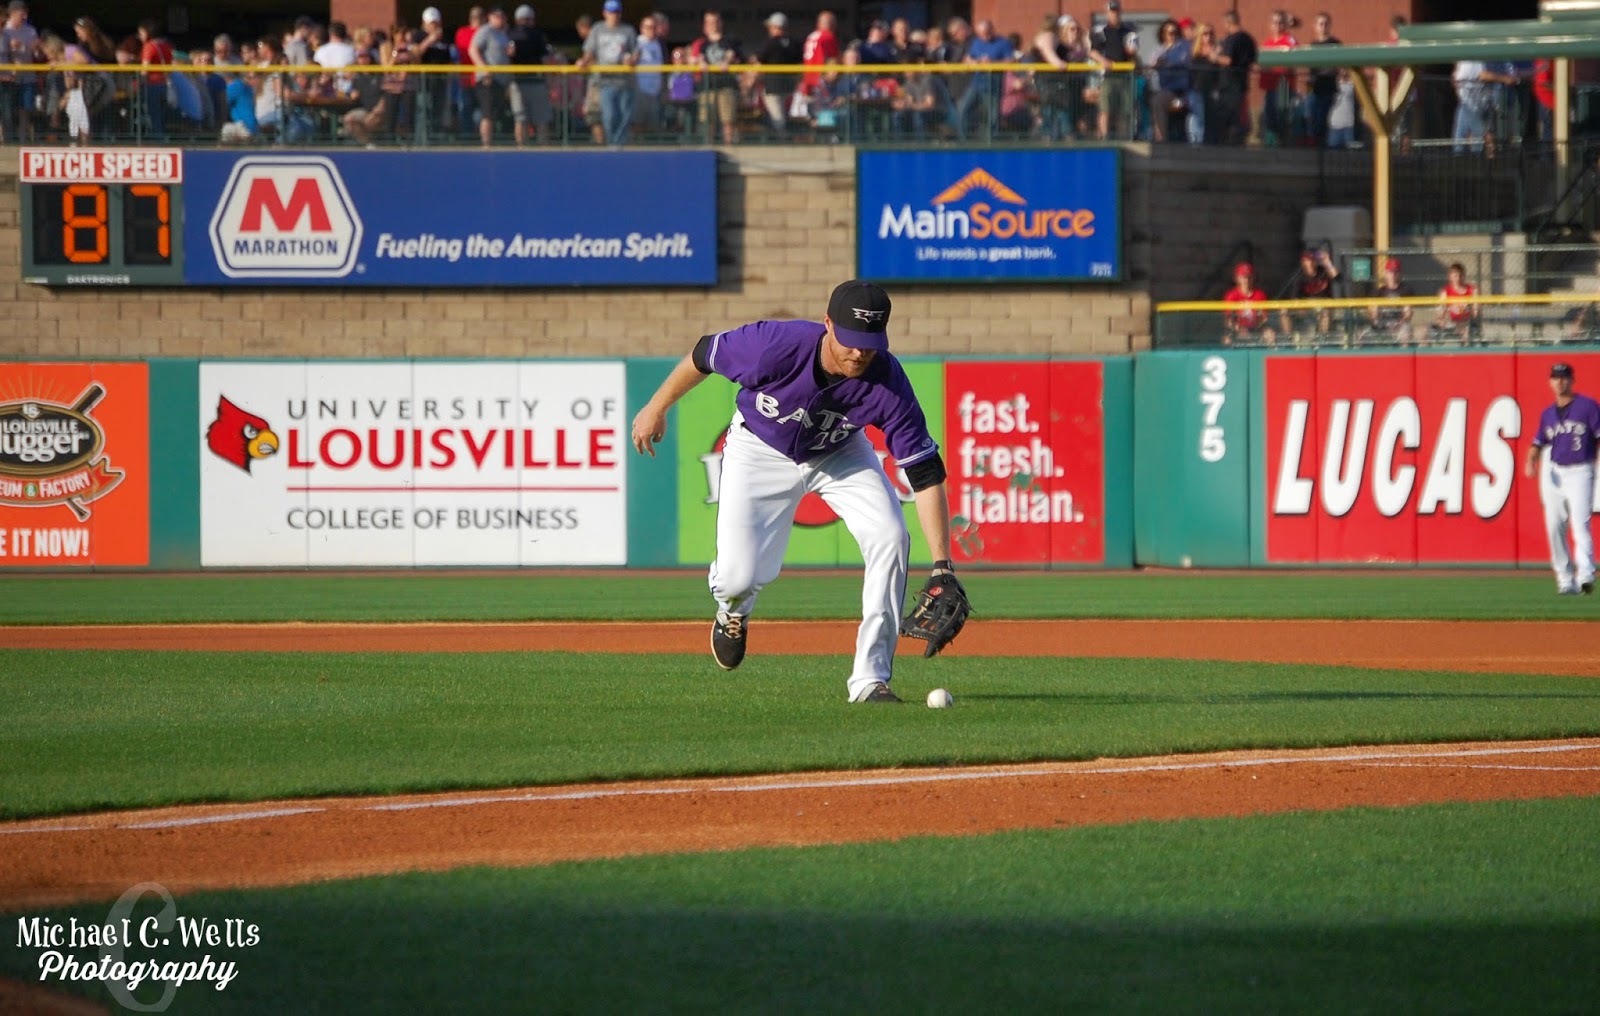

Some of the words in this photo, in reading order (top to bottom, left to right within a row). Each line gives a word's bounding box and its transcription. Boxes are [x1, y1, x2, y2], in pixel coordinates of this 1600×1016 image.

[29, 152, 95, 179] PITCH
[102, 152, 173, 179] SPEED
[238, 177, 333, 233] M
[62, 184, 170, 263] 87
[878, 202, 1095, 239] MainSource
[233, 239, 338, 257] MARATHON
[376, 233, 462, 262] Fueling
[466, 234, 504, 258] the
[505, 233, 621, 258] American
[624, 232, 693, 261] Spirit.
[917, 246, 940, 260] Life
[941, 246, 977, 260] needs
[988, 246, 1022, 262] great
[66, 275, 130, 284] DAKTRONICS
[287, 399, 539, 421] UNIVERSITY
[570, 399, 617, 421] OF
[959, 391, 1039, 433] fast.
[3, 420, 79, 434] LOUISVILLE
[808, 429, 849, 450] 26
[287, 428, 617, 471] LOUISVILLE
[959, 436, 1064, 478] fresh.
[1274, 395, 1521, 518] LUCAS
[1572, 435, 1582, 452] 3
[39, 472, 91, 498] FACTORY
[959, 482, 1085, 523] italian.
[287, 508, 404, 531] COLLEGE
[413, 508, 448, 531] OF
[457, 508, 579, 531] BUSINESS
[12, 528, 32, 556] IT
[35, 528, 89, 556] NOW!
